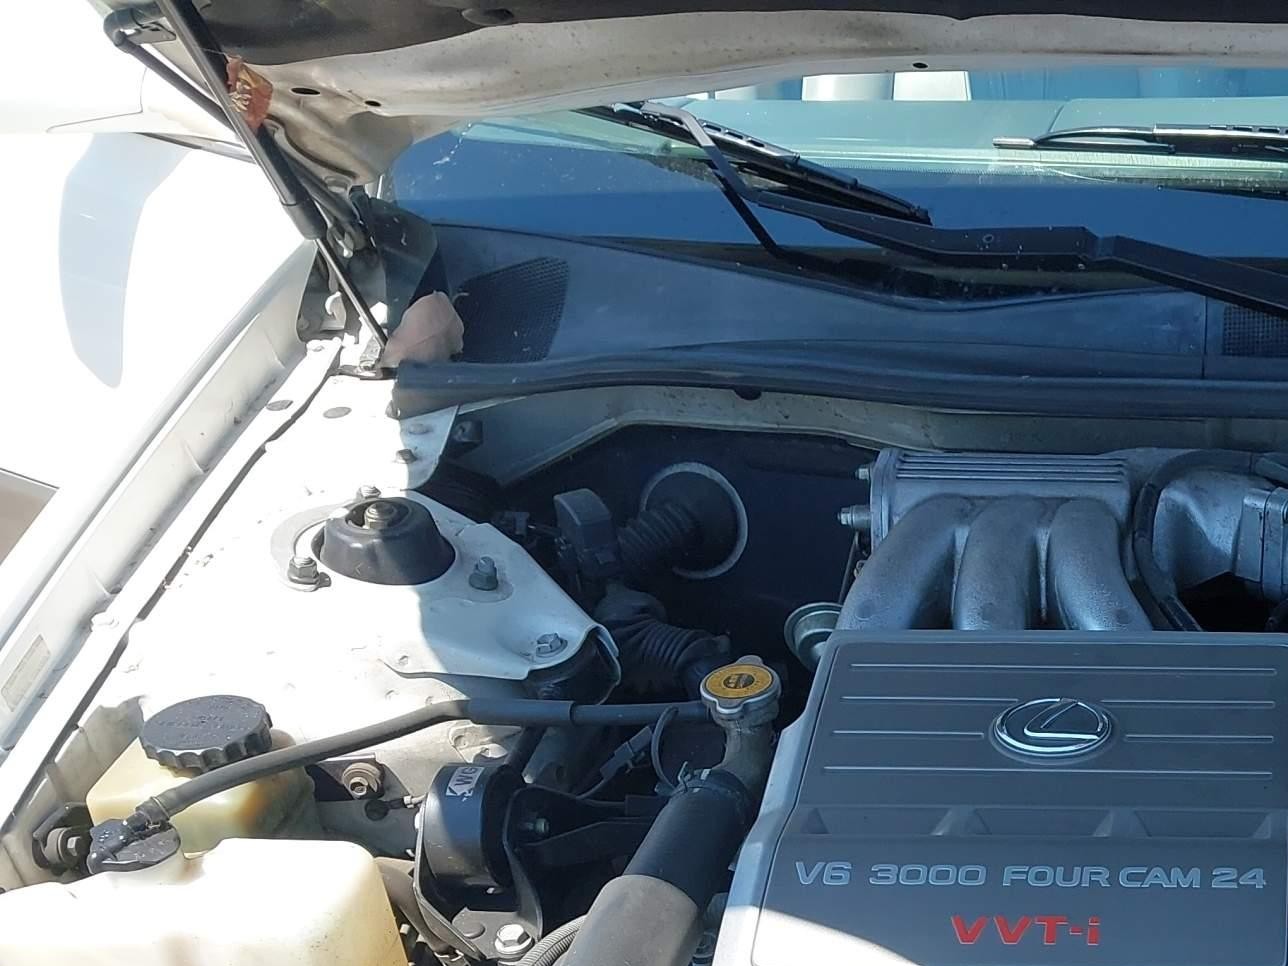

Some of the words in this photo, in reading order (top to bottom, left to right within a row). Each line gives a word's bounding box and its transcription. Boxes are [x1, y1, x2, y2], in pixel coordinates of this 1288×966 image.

[795, 861, 852, 886] V6
[868, 863, 987, 887] 3000
[1002, 866, 1110, 887] FOUR
[1118, 867, 1201, 888] CAM
[1211, 867, 1267, 889] 24
[951, 915, 1100, 945] VVT-i
